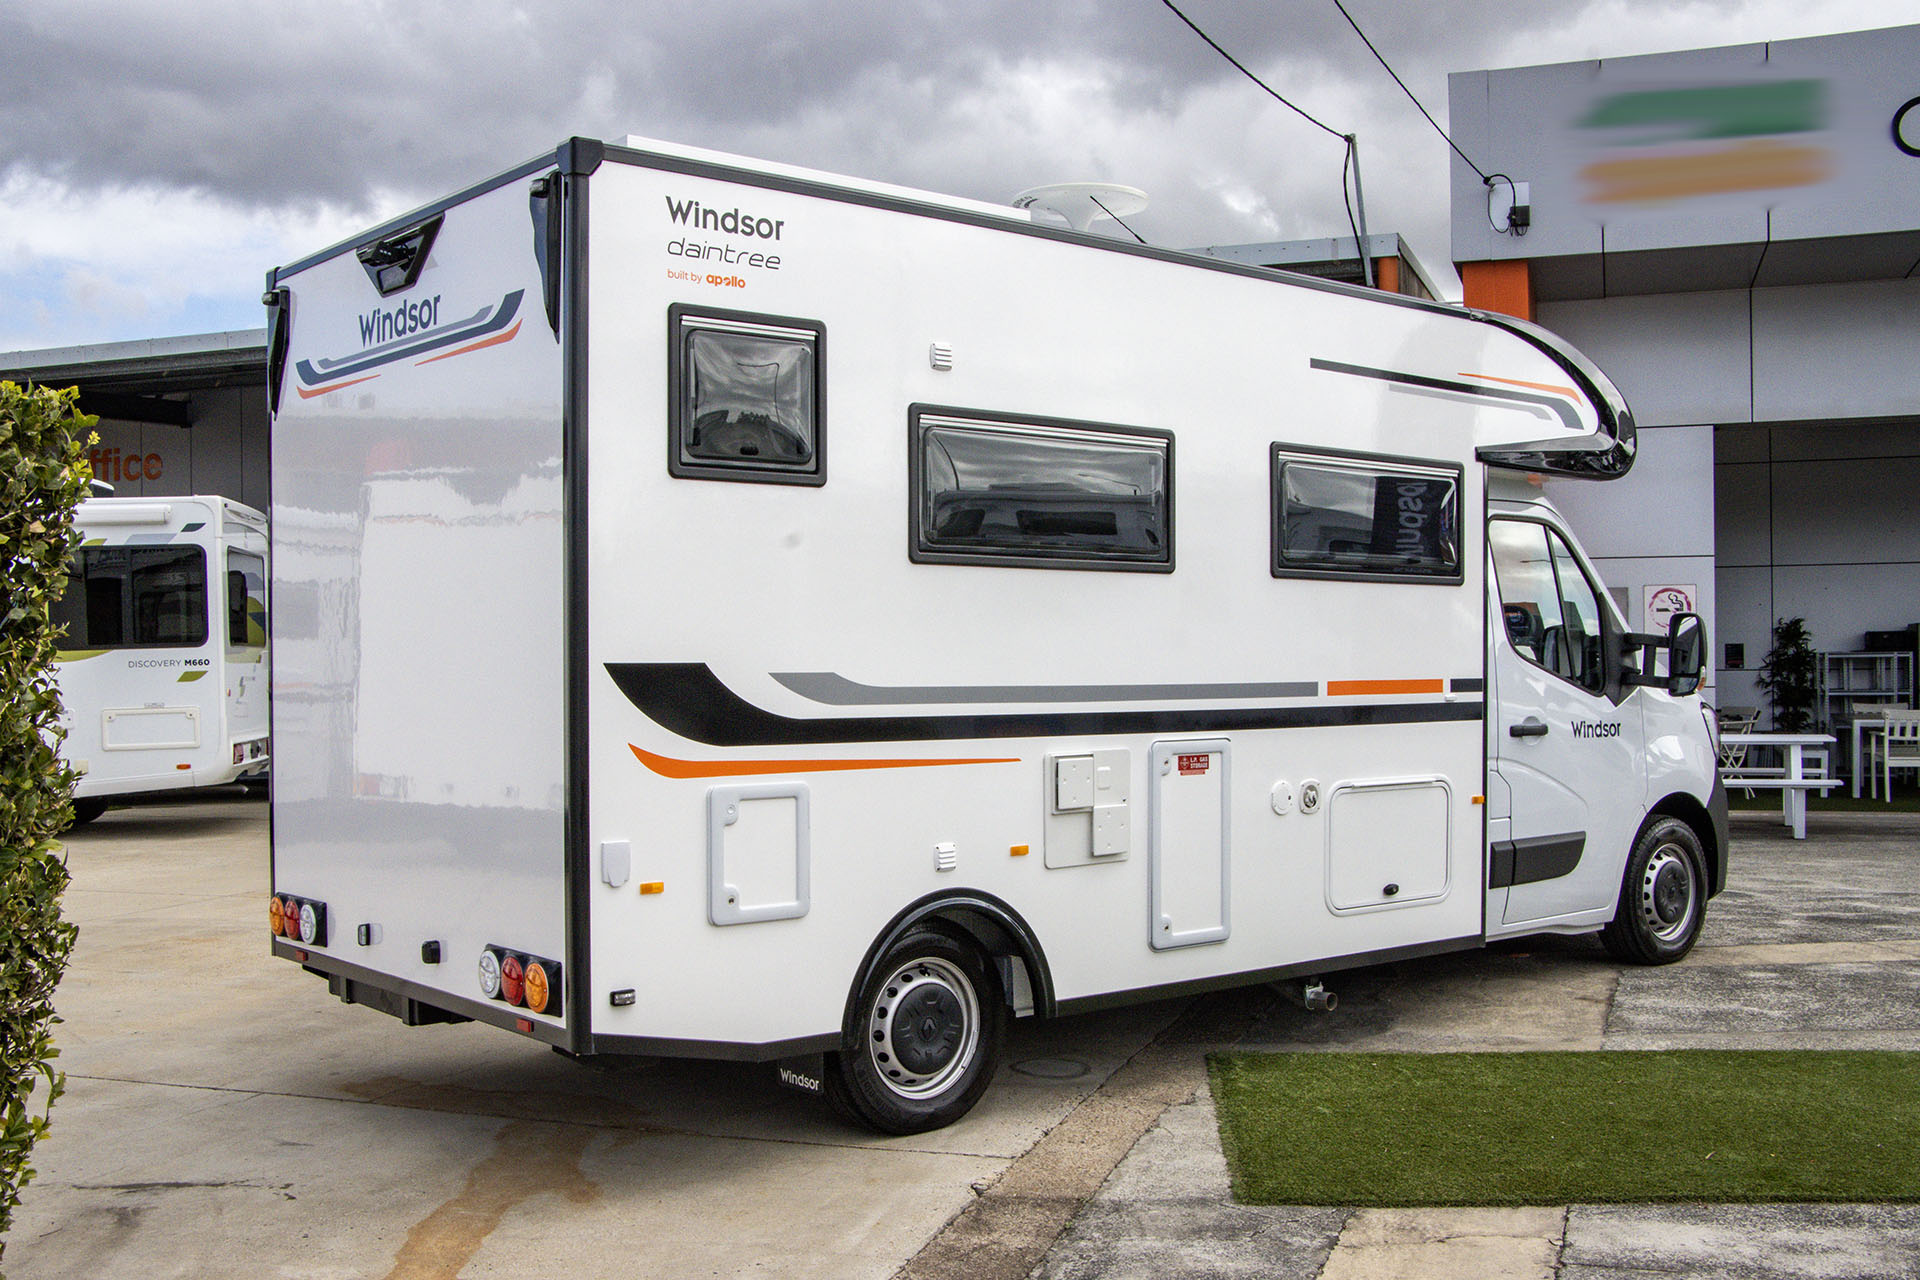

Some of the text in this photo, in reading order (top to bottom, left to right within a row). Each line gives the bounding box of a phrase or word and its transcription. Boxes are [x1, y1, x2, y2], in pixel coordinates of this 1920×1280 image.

[665, 195, 785, 241] Windsor
[667, 237, 781, 270] daintree
[667, 268, 746, 289] built by apollo
[358, 294, 441, 348] Windsor
[89, 447, 164, 482] ffice
[128, 658, 210, 669] DISCOVERY M660
[1571, 719, 1621, 739] Windsor
[780, 1067, 820, 1091] Windsor
